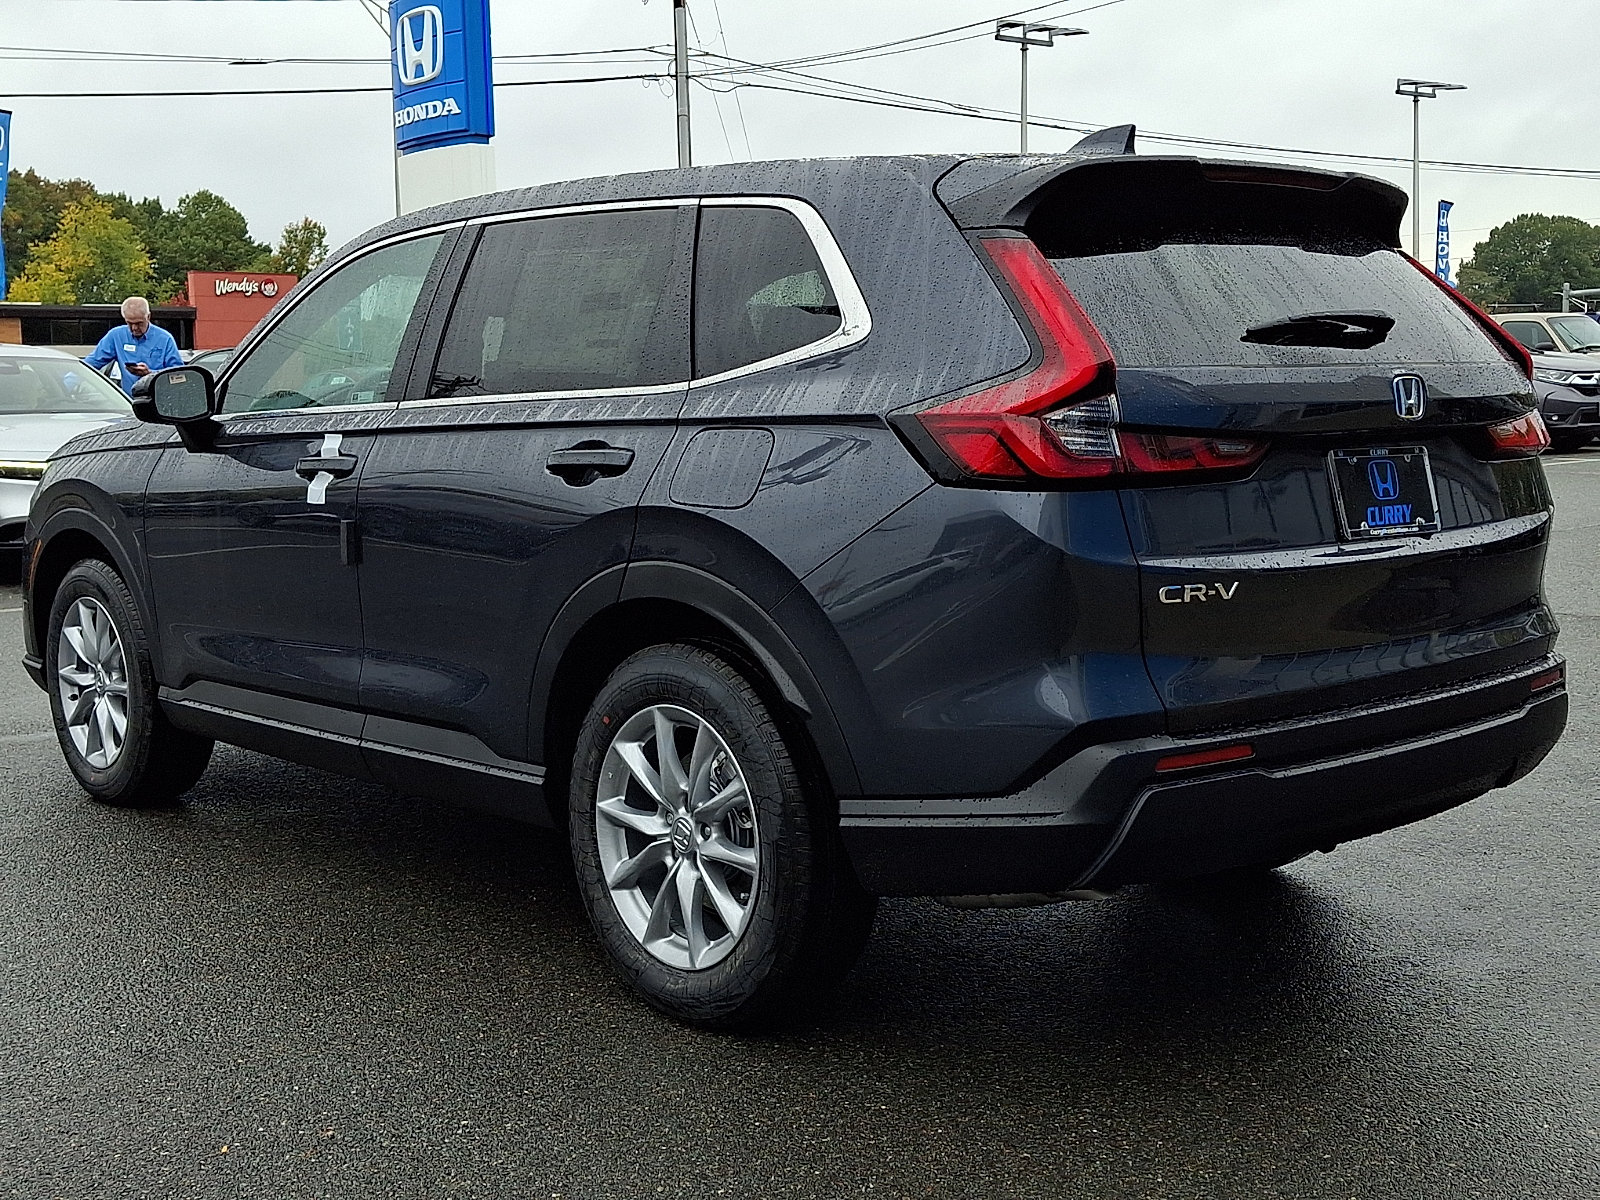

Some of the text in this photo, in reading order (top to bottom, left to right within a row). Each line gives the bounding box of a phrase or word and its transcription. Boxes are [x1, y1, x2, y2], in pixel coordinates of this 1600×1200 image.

[395, 98, 461, 128] HONDA
[215, 277, 259, 296] Wendy's
[1367, 504, 1412, 526] CURRY
[1159, 582, 1239, 603] CR-V
